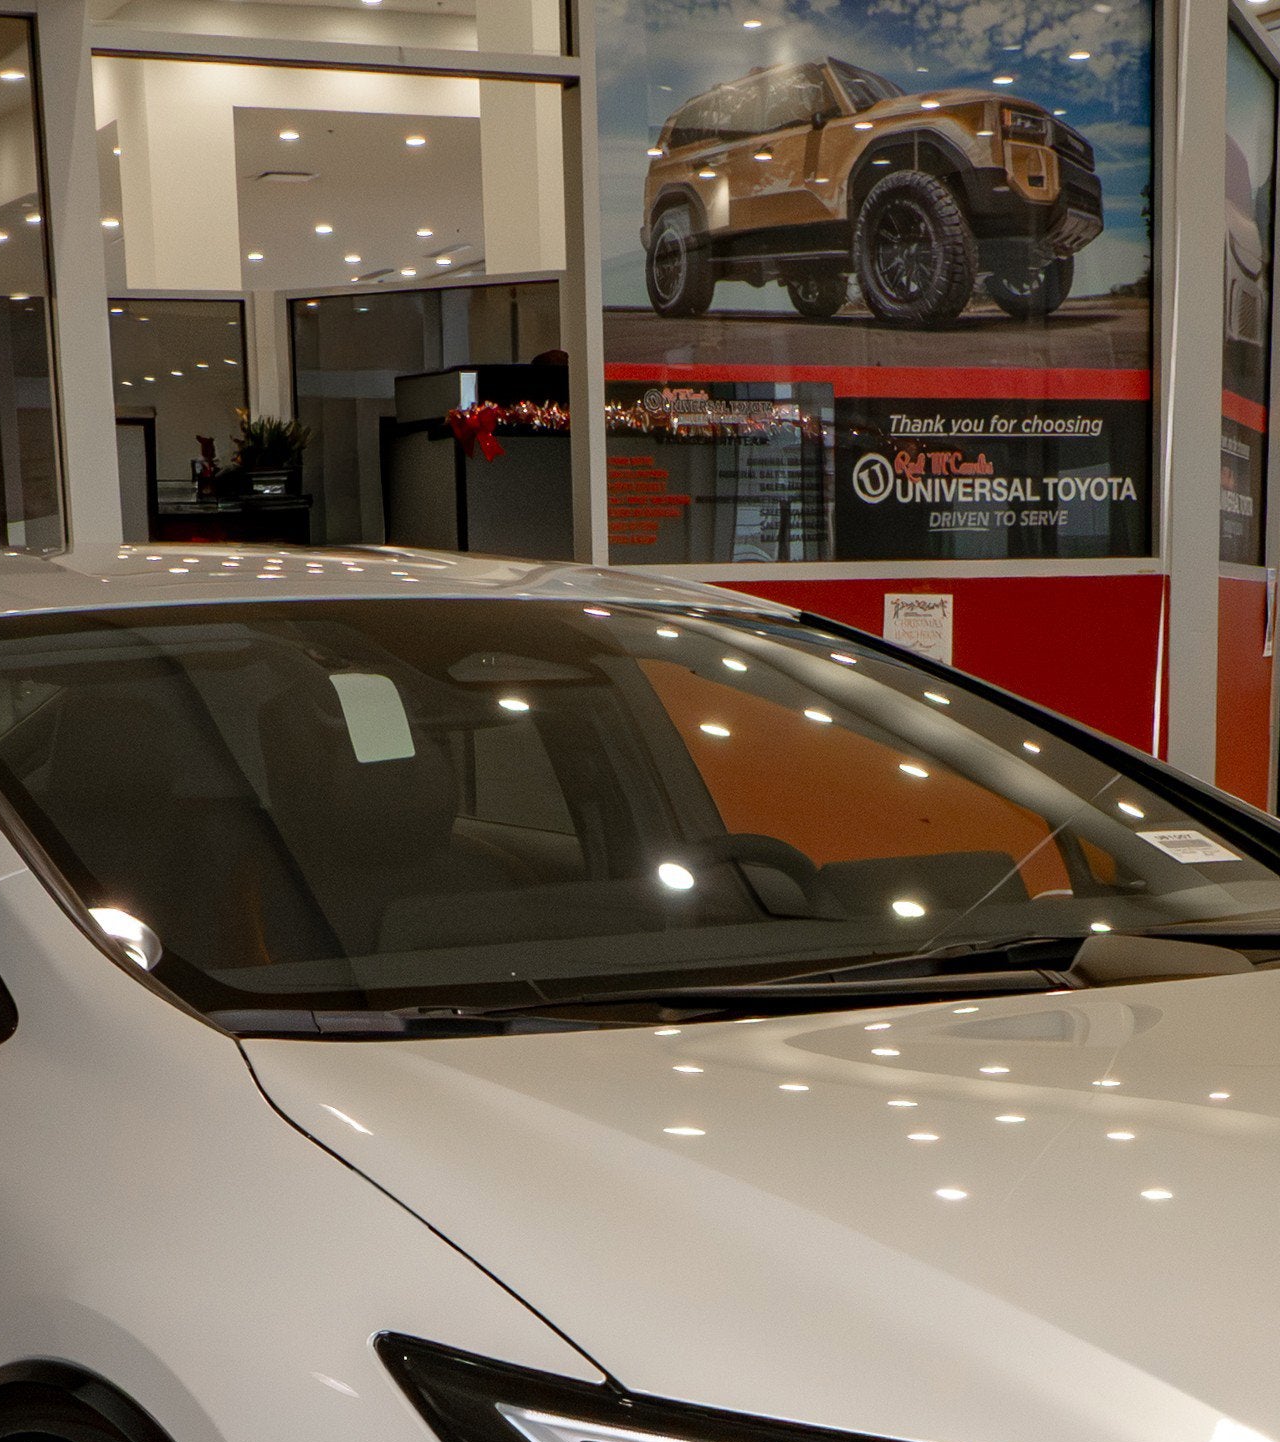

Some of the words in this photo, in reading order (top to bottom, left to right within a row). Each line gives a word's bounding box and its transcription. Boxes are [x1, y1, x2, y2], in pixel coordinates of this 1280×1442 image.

[890, 414, 945, 434] Thank
[949, 419, 985, 436] you
[989, 414, 1017, 434] for
[1021, 416, 1103, 437] choosing
[893, 450, 927, 482] Red
[895, 477, 1041, 503] UNIVERSAL
[1042, 476, 1138, 502] TOYOTA
[928, 510, 991, 529] DRIVEN
[994, 510, 1017, 528] TO
[1019, 510, 1070, 527] SERVE
